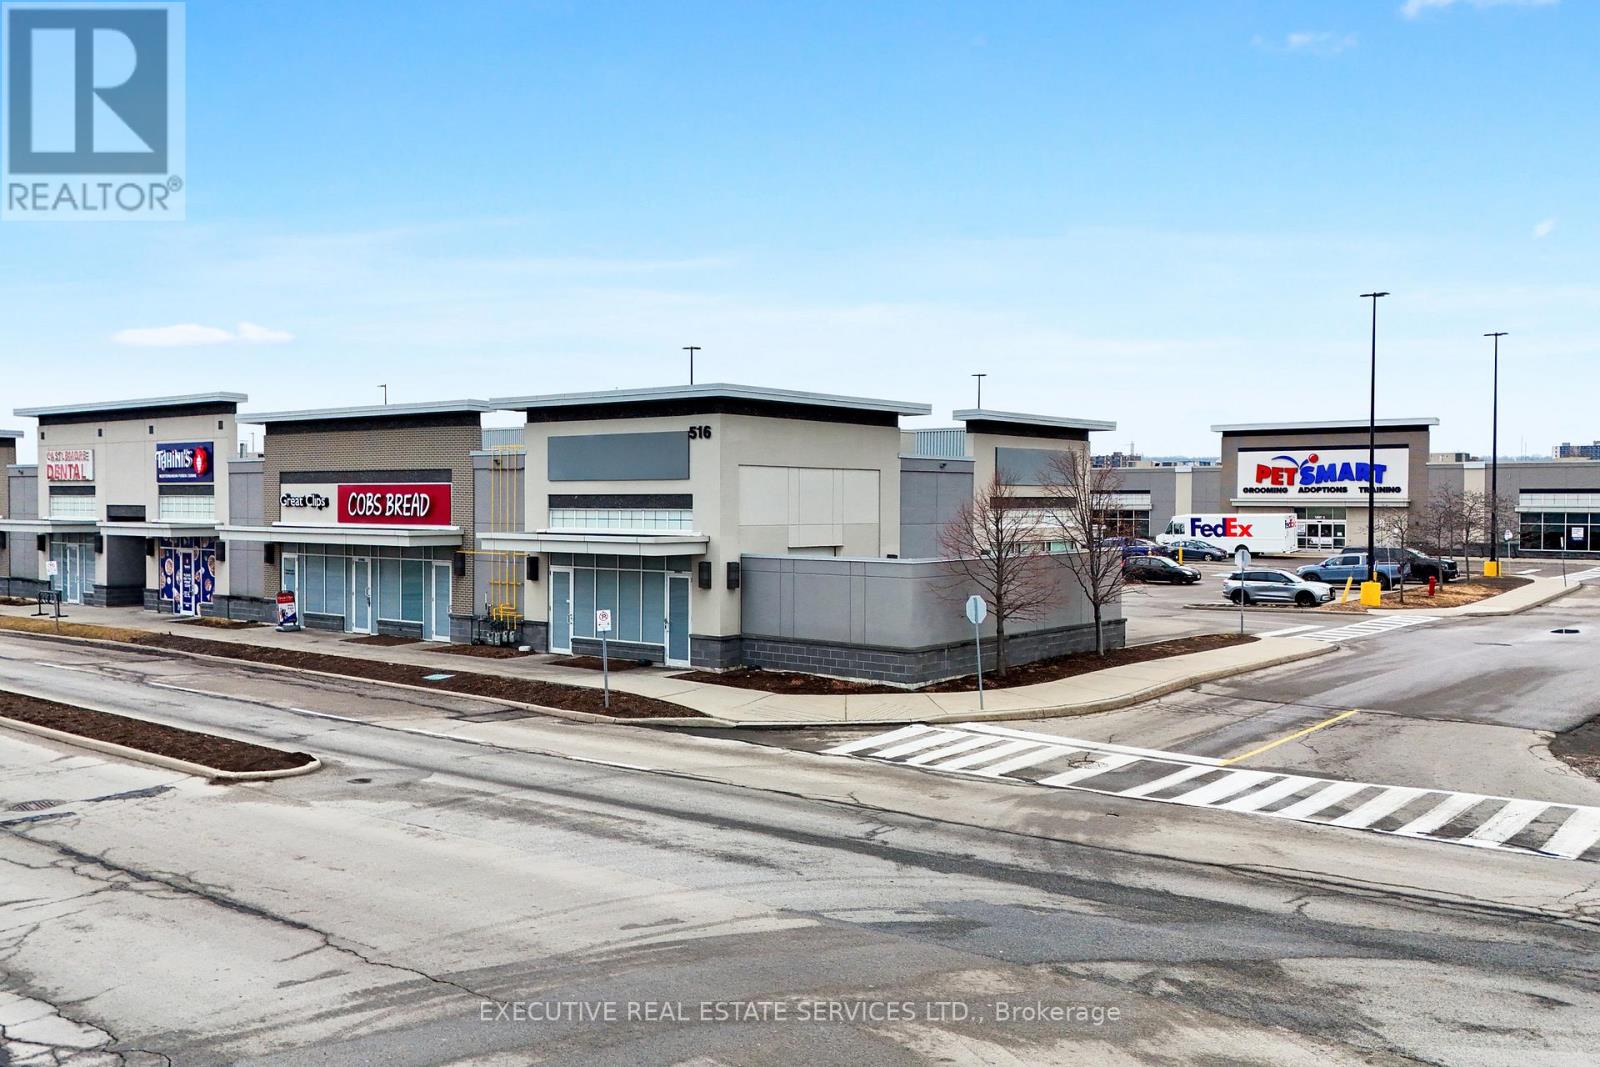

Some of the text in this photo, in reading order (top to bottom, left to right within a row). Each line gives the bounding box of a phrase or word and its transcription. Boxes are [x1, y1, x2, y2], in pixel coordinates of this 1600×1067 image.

[688, 425, 712, 440] 516
[47, 464, 86, 480] DENTAL
[1243, 486, 1288, 494] GROOMING
[1298, 486, 1348, 494] ADOPTIONS
[280, 493, 327, 509] Great Clips
[348, 492, 430, 517] COBS BREAD
[1190, 517, 1254, 538] FedEx
